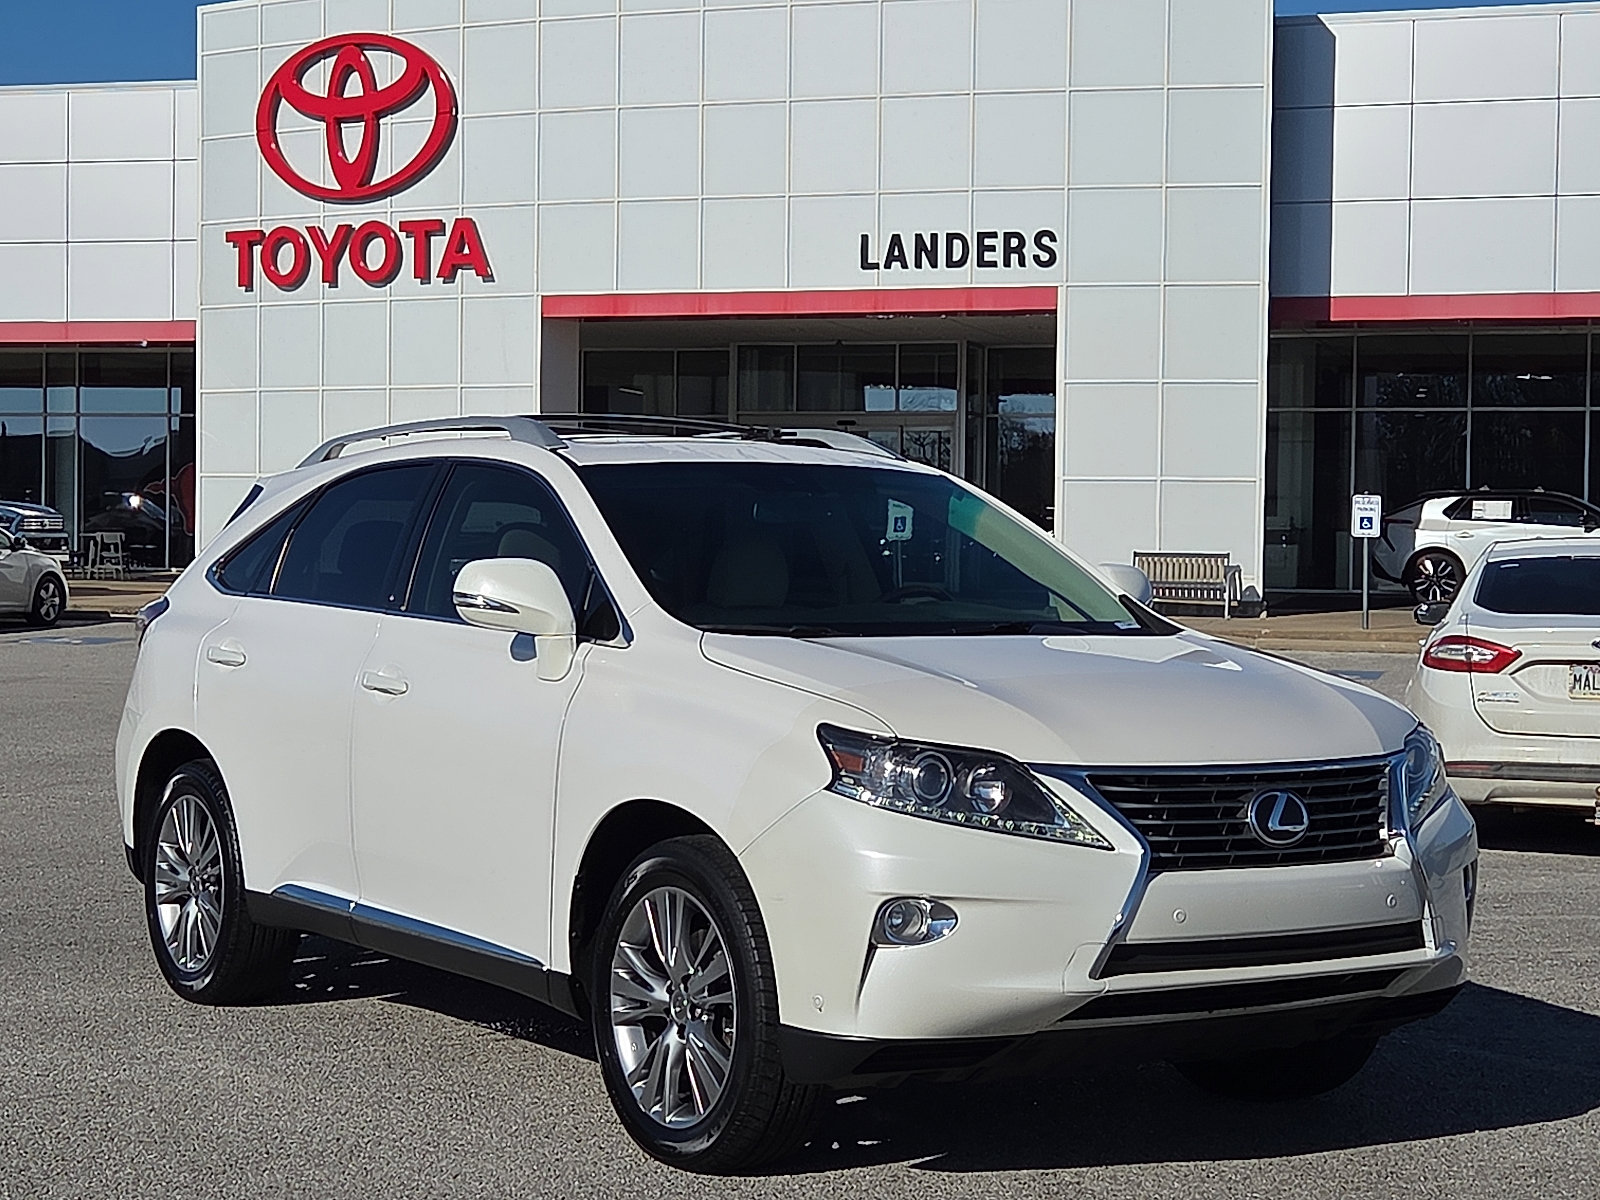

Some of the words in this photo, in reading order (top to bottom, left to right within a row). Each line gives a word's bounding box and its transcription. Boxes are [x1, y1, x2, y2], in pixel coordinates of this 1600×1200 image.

[226, 218, 495, 292] TOYOTA
[860, 229, 1058, 270] LANDERS
[1573, 672, 1600, 691] MAL
